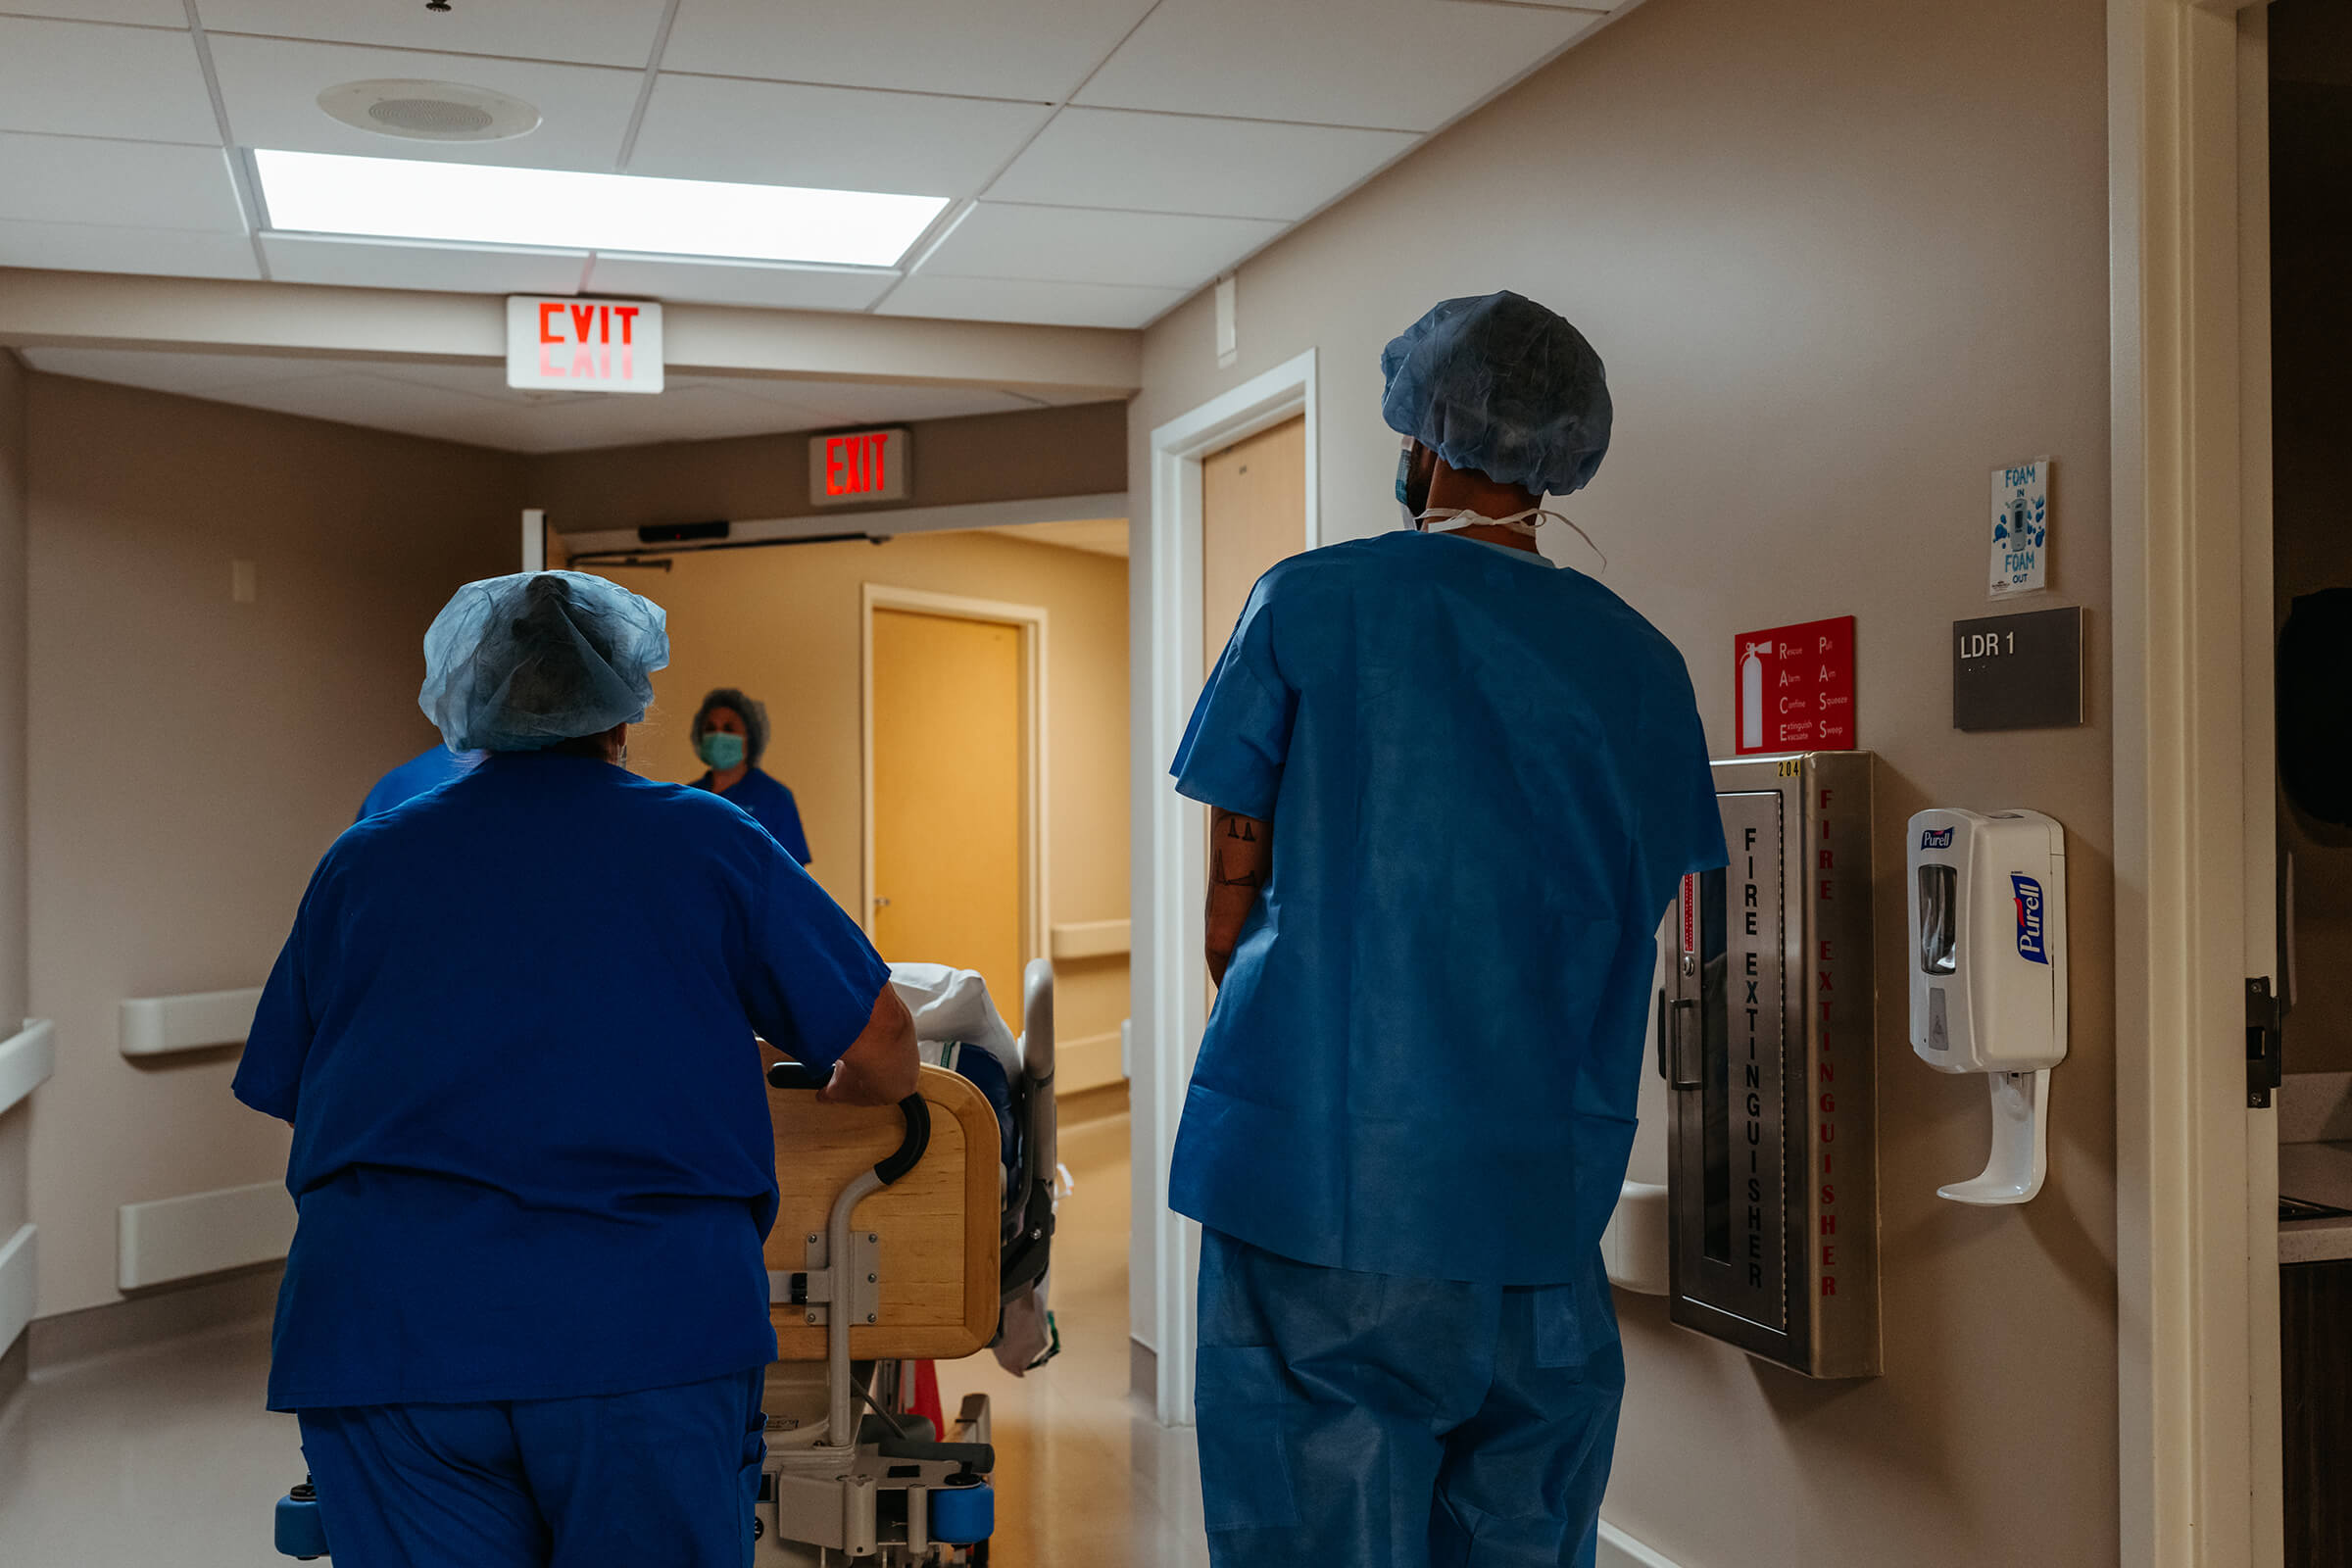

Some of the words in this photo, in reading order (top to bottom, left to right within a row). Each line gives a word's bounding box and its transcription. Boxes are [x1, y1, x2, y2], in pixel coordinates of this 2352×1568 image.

[539, 302, 639, 380] EXIT
[826, 433, 888, 496] EXIT
[2005, 465, 2035, 488] FOAM
[2016, 488, 2025, 498] IN
[2005, 550, 2034, 572] FOAM
[2012, 573, 2028, 584] OUT
[1961, 633, 1999, 659] LDR
[2006, 631, 2015, 655] 1
[1779, 760, 1799, 777] 204
[1820, 788, 1835, 901] FIRE
[1924, 831, 1950, 847] Purell
[1744, 828, 1757, 936] FIRE
[2019, 883, 2041, 954] Purell
[1745, 952, 1763, 1290] EXTINGUISHER
[1818, 940, 1837, 1298] EXTINGUISHER
